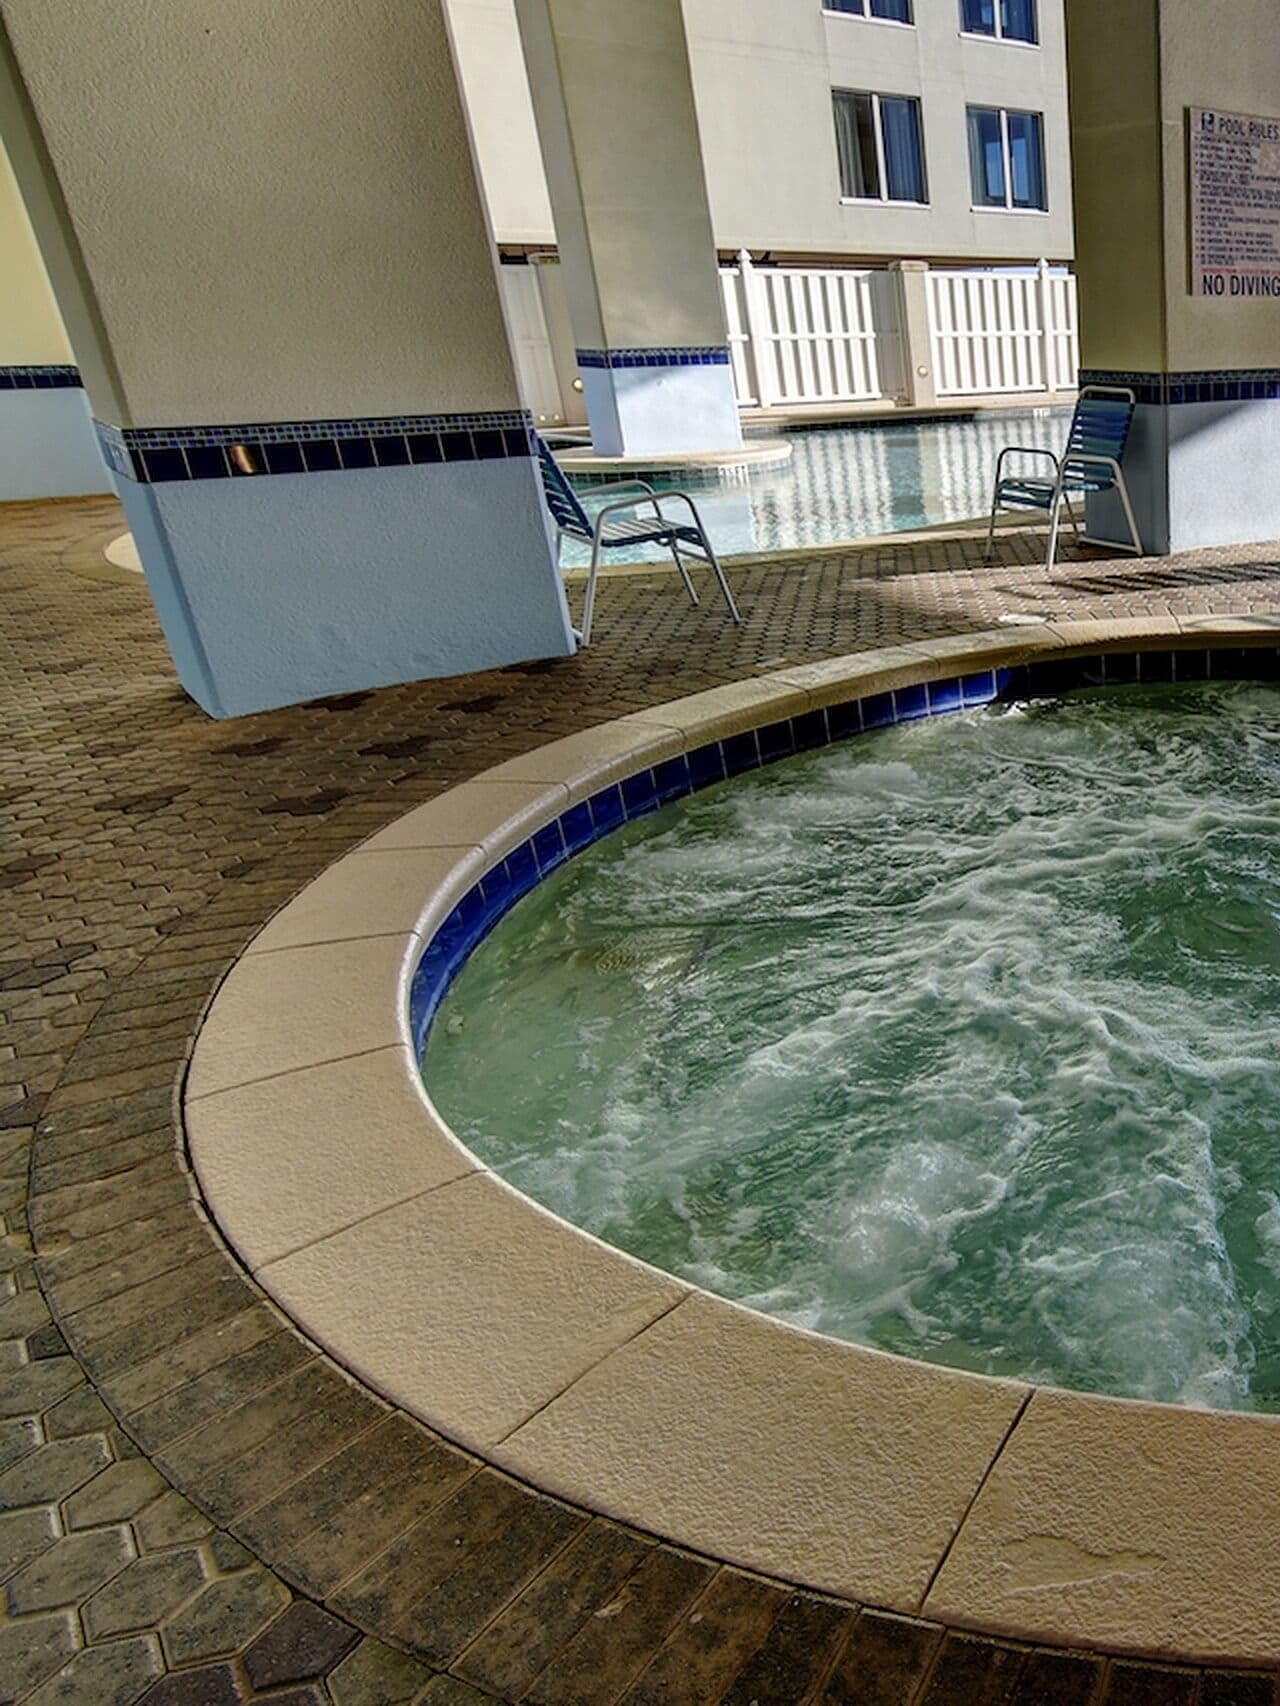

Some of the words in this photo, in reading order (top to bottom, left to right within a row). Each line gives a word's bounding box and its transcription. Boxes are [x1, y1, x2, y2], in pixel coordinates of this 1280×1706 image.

[1218, 117, 1245, 136] POOL
[1249, 121, 1280, 140] RULES
[1203, 274, 1225, 295] NO
[1230, 275, 1280, 297] DIVING
